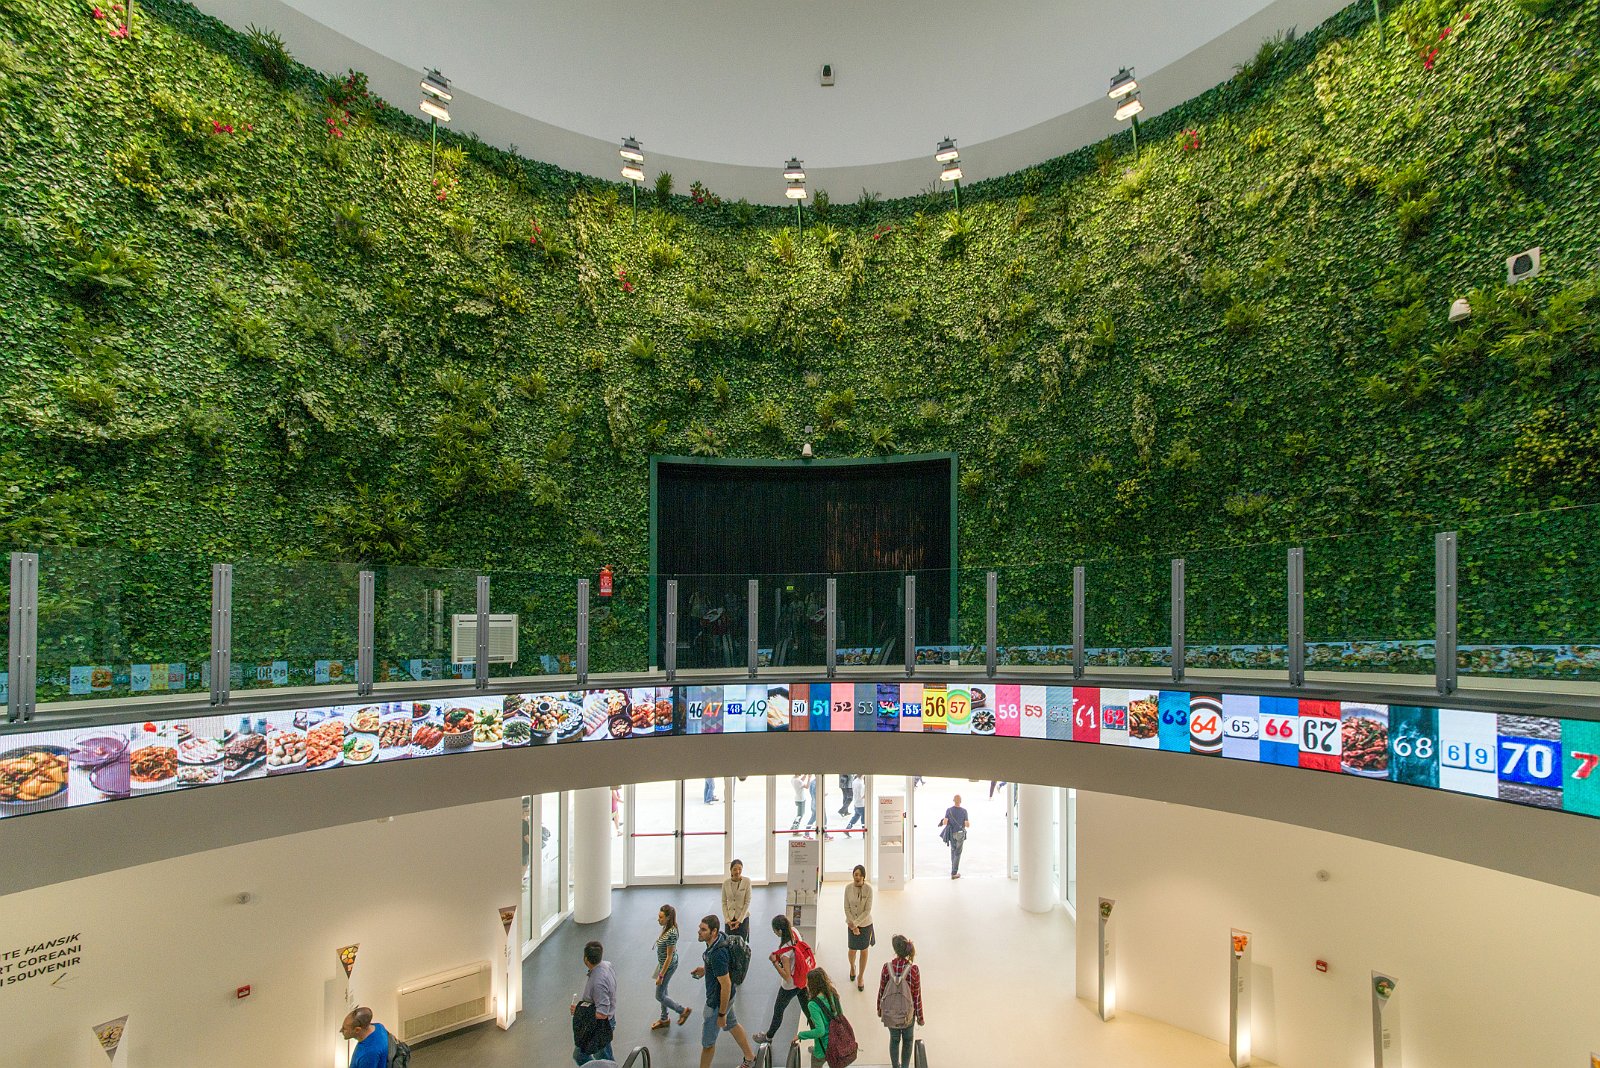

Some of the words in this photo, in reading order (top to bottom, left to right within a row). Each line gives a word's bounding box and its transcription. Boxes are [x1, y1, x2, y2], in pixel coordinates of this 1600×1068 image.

[689, 702, 702, 718] 46
[703, 702, 722, 717] 47
[729, 704, 740, 713] 48
[746, 700, 767, 717] 49
[794, 702, 805, 713] 50
[813, 700, 829, 716] 51
[833, 701, 852, 712] 52
[858, 701, 874, 714] 53
[905, 705, 919, 715] 55
[925, 697, 946, 717] 56
[950, 702, 966, 714] 57
[998, 704, 1019, 719] 58
[1024, 704, 1043, 718] 59
[1075, 705, 1097, 729] 61
[1103, 708, 1125, 725] 62
[1162, 709, 1187, 726] 63
[1190, 715, 1217, 735] 64
[1231, 719, 1250, 733] 65
[1265, 718, 1293, 739] 66
[1303, 719, 1337, 752] 67
[1393, 735, 1433, 759] 68
[1502, 742, 1552, 778] 70
[17, 944, 82, 969] COREANI
[24, 932, 81, 955] HANSIK
[6, 957, 81, 985] SOUVENIR
